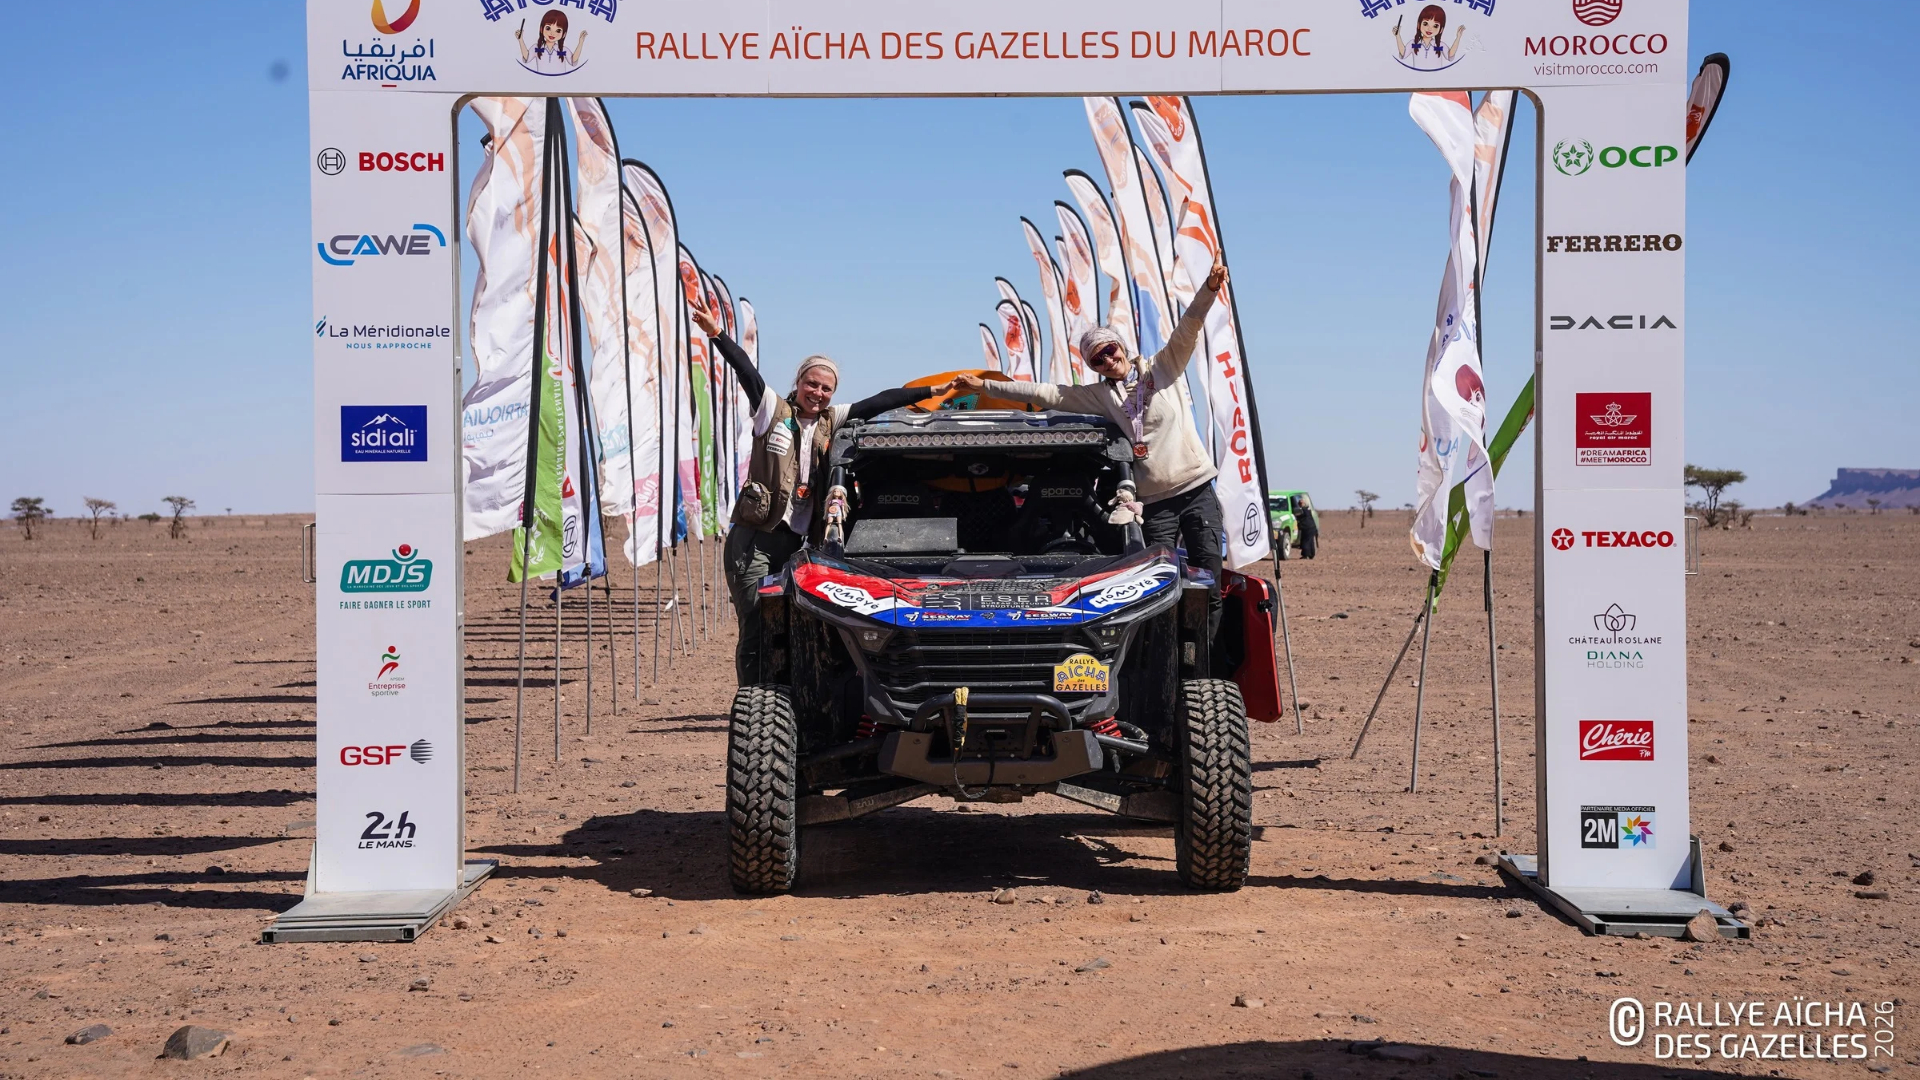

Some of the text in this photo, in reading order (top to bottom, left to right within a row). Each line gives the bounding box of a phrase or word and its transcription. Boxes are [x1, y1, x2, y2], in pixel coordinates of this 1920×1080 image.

[342, 38, 434, 64] افريقيا
[636, 26, 1312, 59] RALLYE AÏCHA DES GAZELLES DU MAROC
[1524, 33, 1669, 57] MOROCCO
[341, 64, 437, 82] AFRIQUIA
[1533, 62, 1658, 76] visitmorocco.com
[358, 152, 444, 172] BOSCH
[1599, 145, 1678, 168] OCP
[330, 235, 431, 256] CAWE
[1546, 233, 1683, 253] FERRERO
[330, 322, 450, 338] La Méridionale
[1550, 315, 1677, 329] DACIA
[351, 428, 414, 447] sidi ali
[877, 494, 919, 505] sparco
[1041, 486, 1083, 497] sparco
[1582, 530, 1675, 548] TEXACO
[347, 564, 426, 584] MDJS
[340, 600, 431, 609] FAIRE GAGNER LE SPORT
[1568, 636, 1663, 644] CHÂTEAU ROSLANE
[1587, 651, 1643, 660] DIANA
[368, 683, 406, 691] Entreprise
[1055, 683, 1107, 691] GAZELLES
[1583, 723, 1653, 751] Chérie
[340, 745, 407, 766] GSF
[361, 809, 417, 840] 24h
[1584, 818, 1617, 843] 2M
[358, 839, 414, 849] LE MANS
